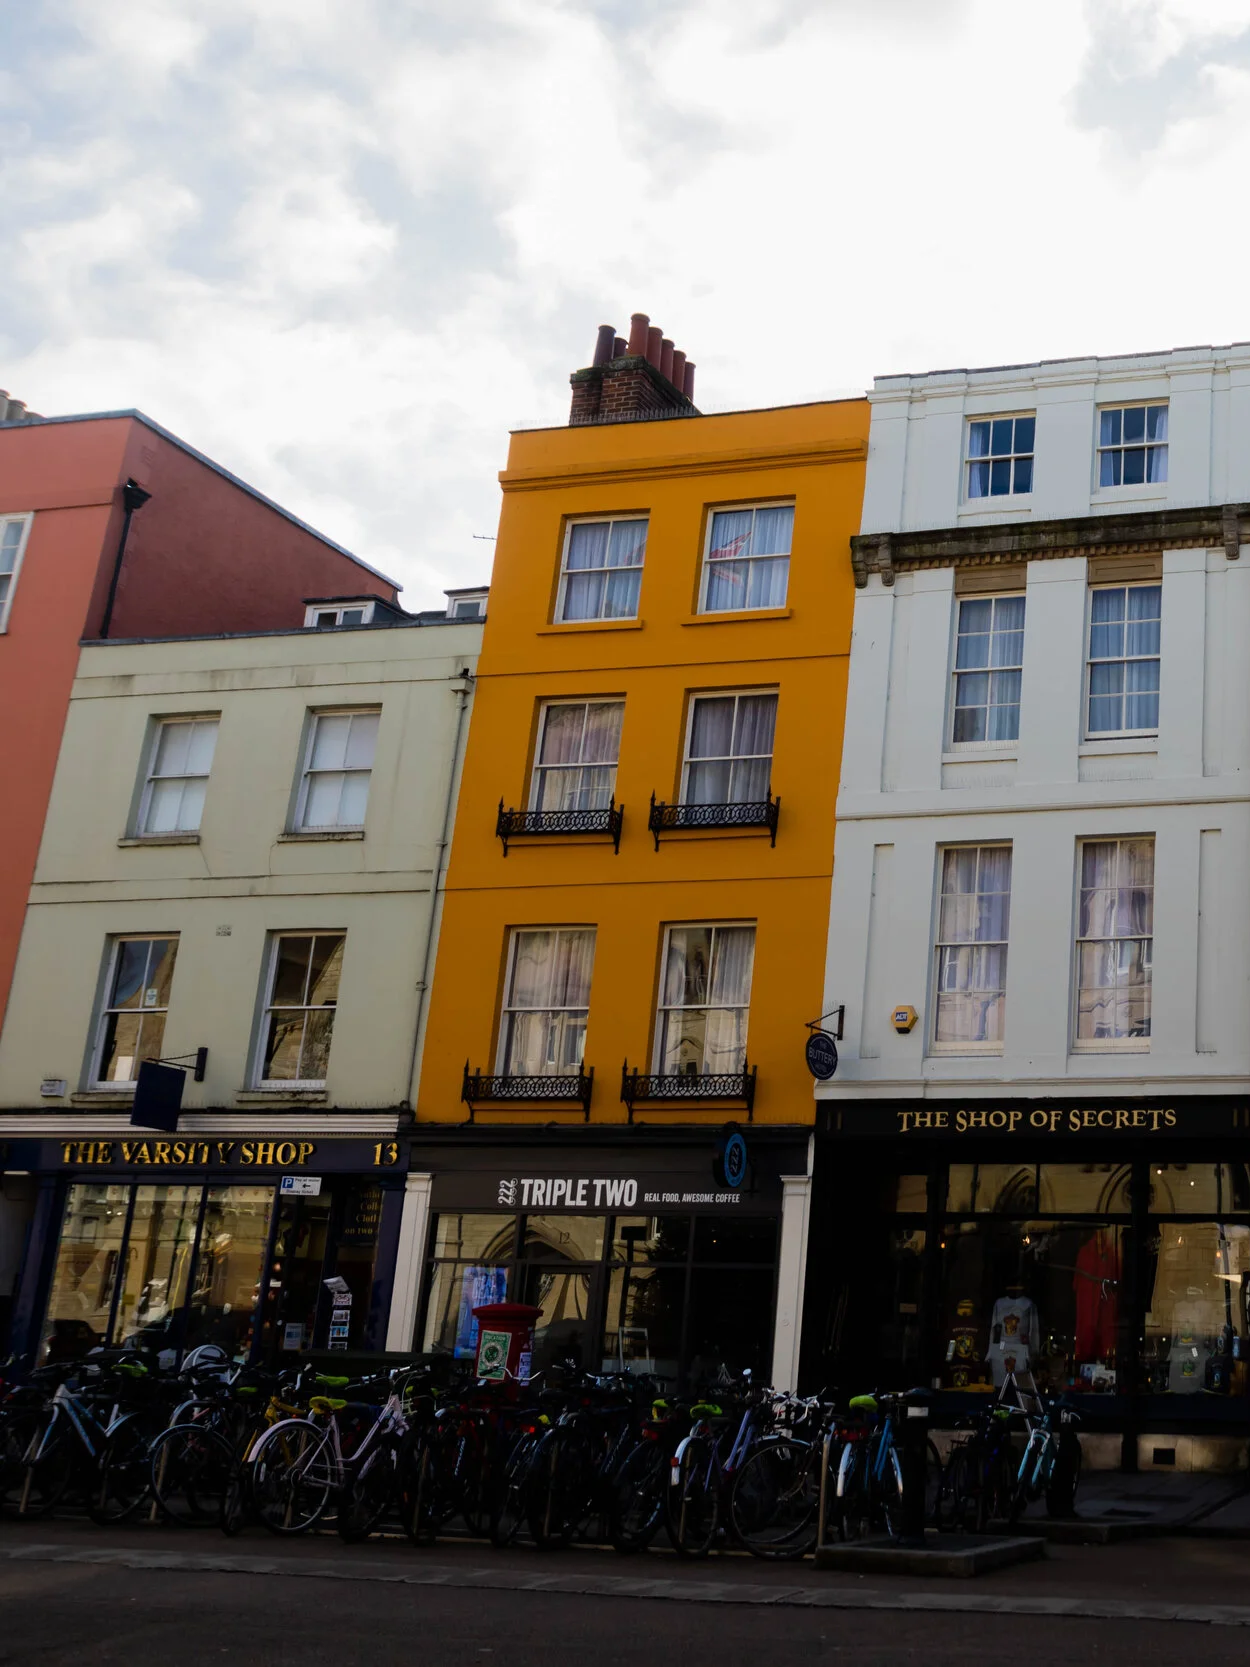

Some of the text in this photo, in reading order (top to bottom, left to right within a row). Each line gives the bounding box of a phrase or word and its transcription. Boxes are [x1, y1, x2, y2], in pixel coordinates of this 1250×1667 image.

[808, 1046, 837, 1067] BUTTERY
[897, 1108, 1178, 1132] THE SHOP OF SECRETS
[60, 1141, 400, 1166] THE VARSITY SHOP 13
[520, 1178, 589, 1207] TRIPLE
[592, 1178, 638, 1207] TWO
[644, 1192, 661, 1203] REAL
[662, 1192, 681, 1203] FOOD,
[681, 1193, 715, 1203] AWESOME
[715, 1193, 741, 1203] COFFEE
[558, 1231, 571, 1245] 12
